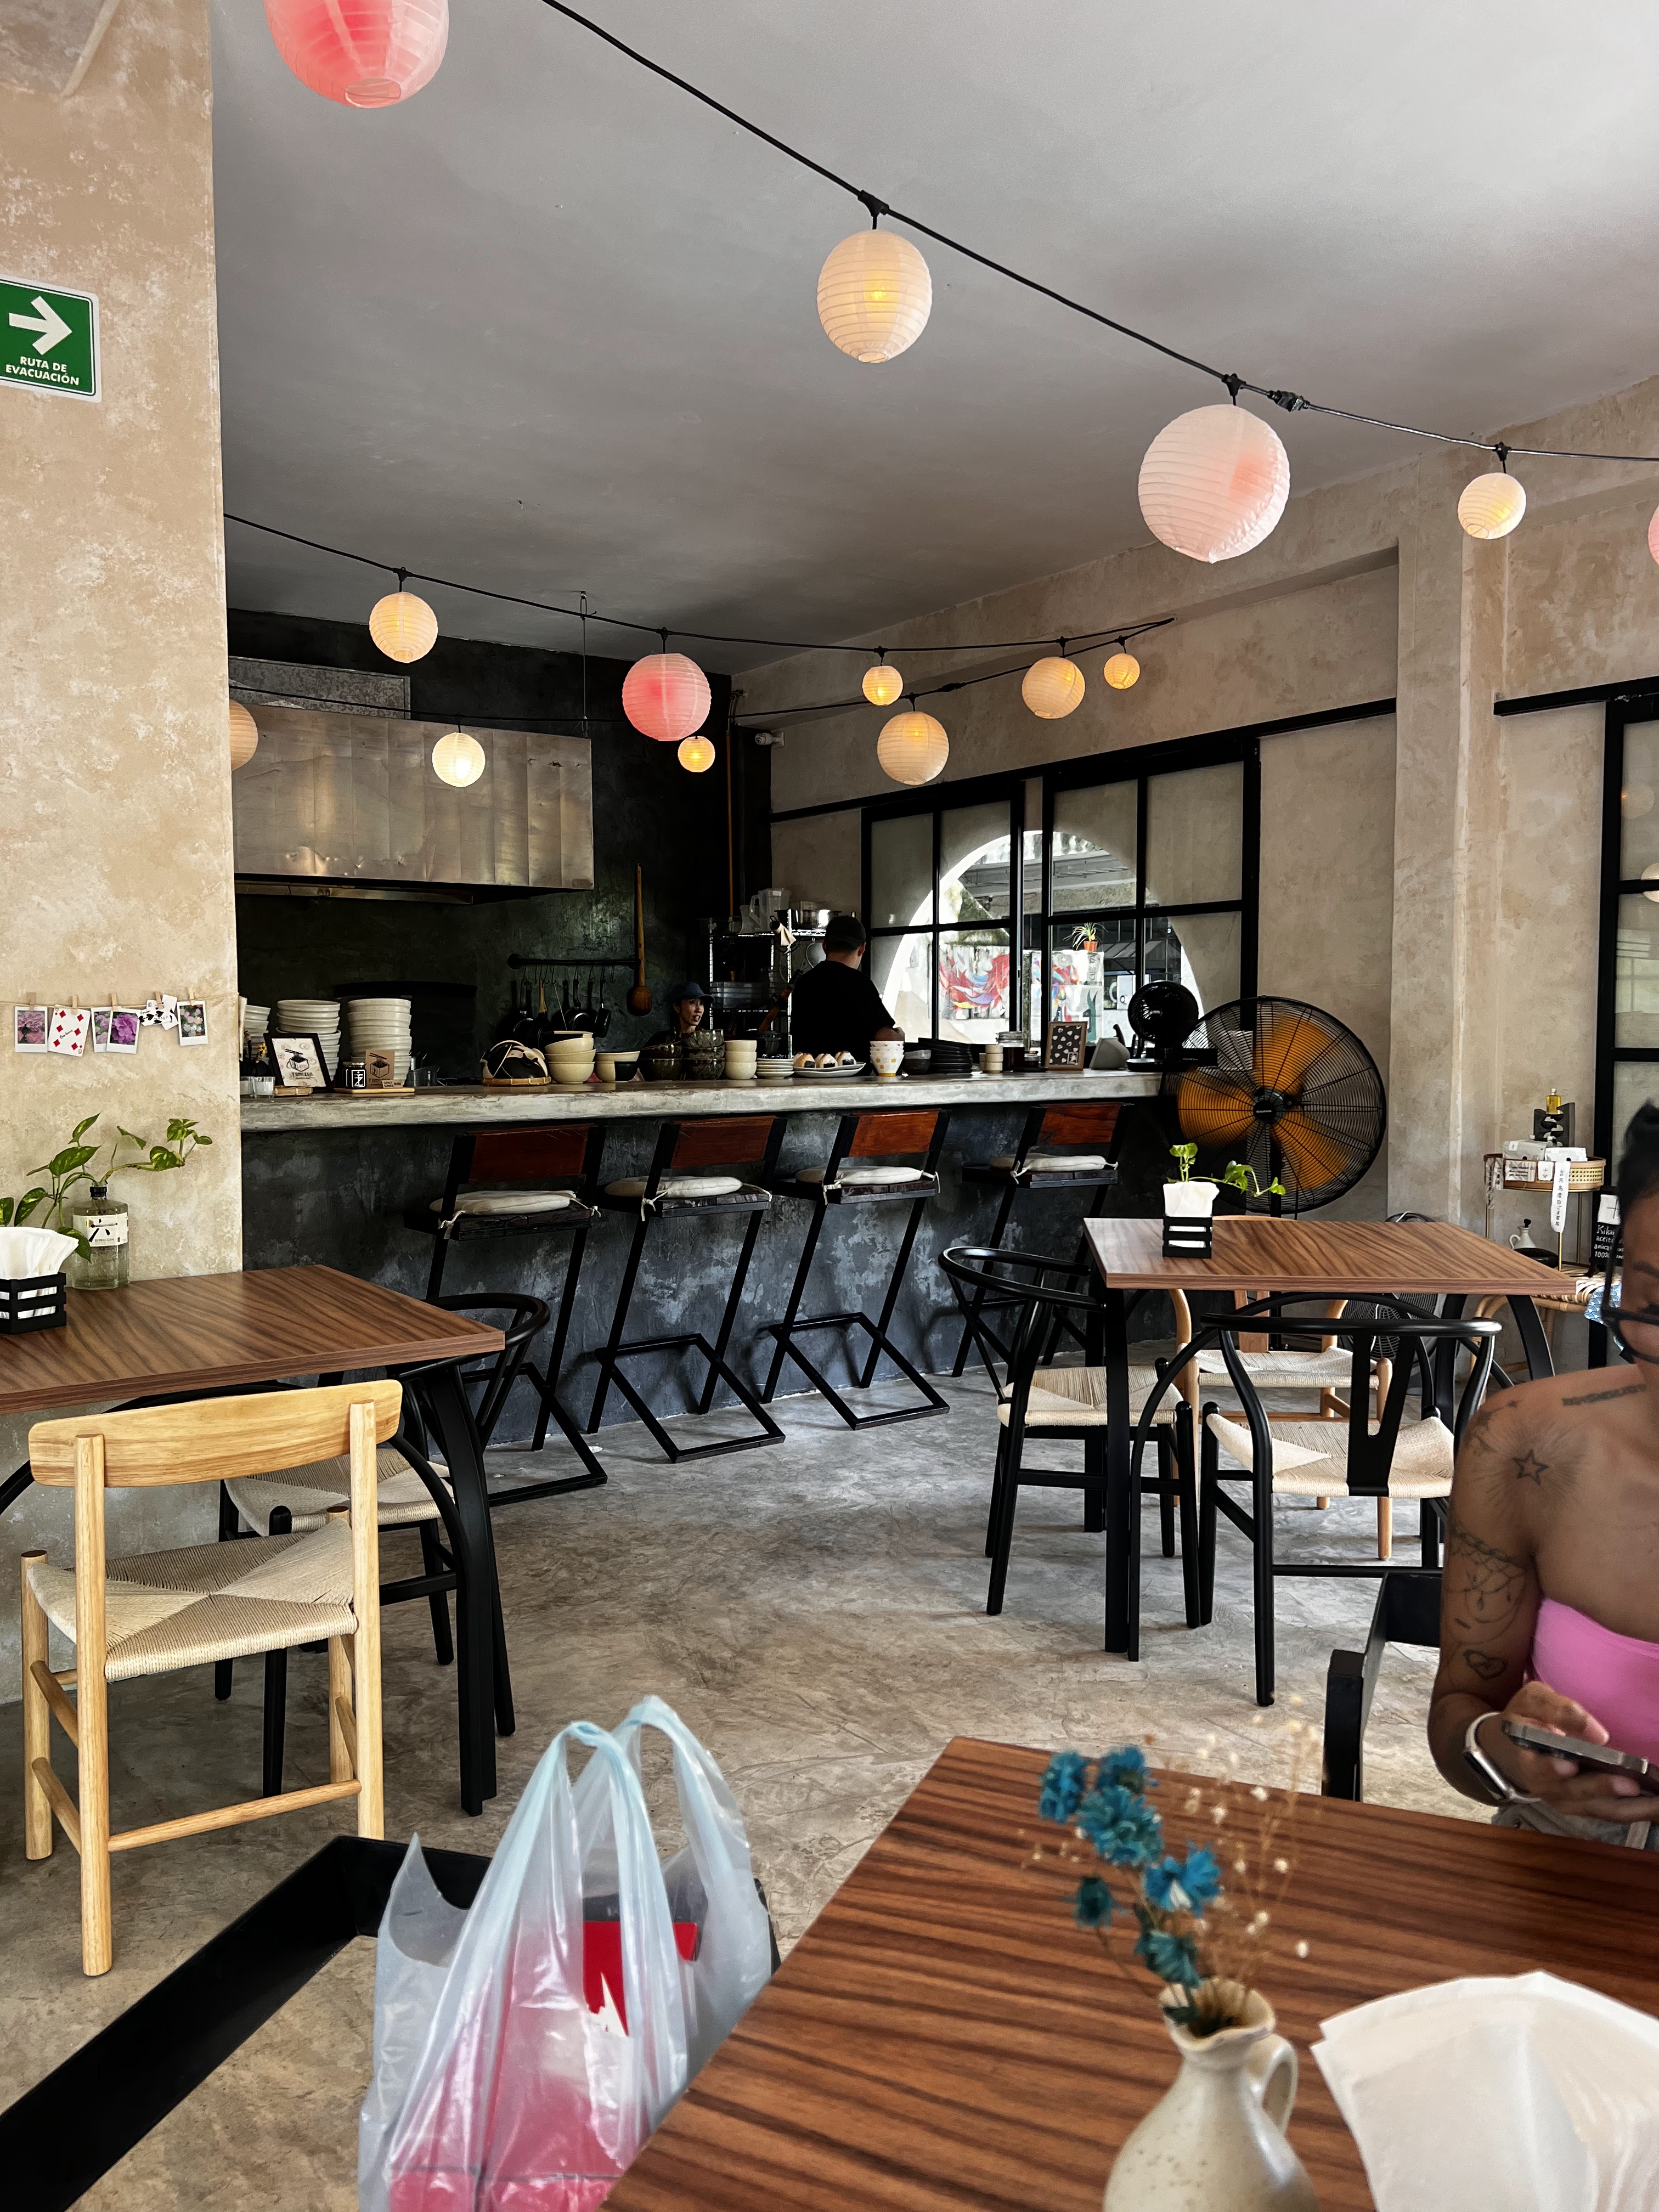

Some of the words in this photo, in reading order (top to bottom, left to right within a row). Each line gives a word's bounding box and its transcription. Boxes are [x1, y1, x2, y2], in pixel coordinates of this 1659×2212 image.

[20, 356, 49, 369] RUTA
[53, 363, 67, 373] DE
[5, 364, 80, 386] EVACUACIÓN
